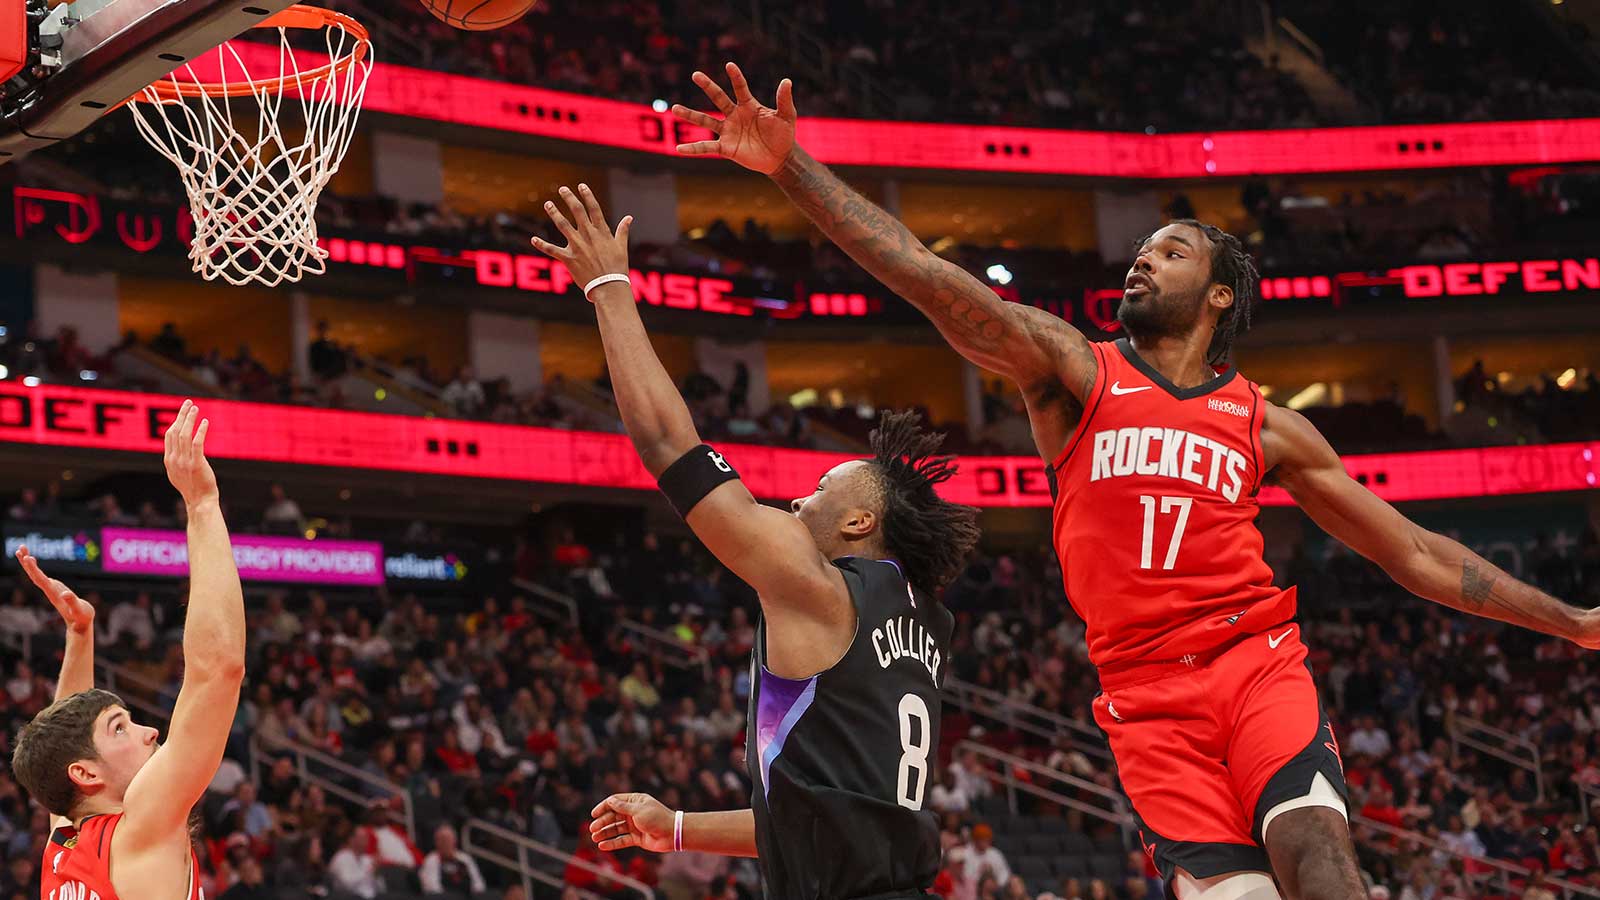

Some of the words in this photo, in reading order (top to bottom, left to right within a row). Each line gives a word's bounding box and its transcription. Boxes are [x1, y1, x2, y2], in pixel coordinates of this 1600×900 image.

[476, 250, 733, 314] DEFNSE
[1208, 398, 1248, 411] MEMORIAL
[1208, 404, 1249, 417] HERMANN
[1090, 426, 1246, 504] ROCKETS
[1140, 495, 1193, 570] 17
[871, 616, 941, 689] COLLIER
[897, 693, 931, 811] 8
